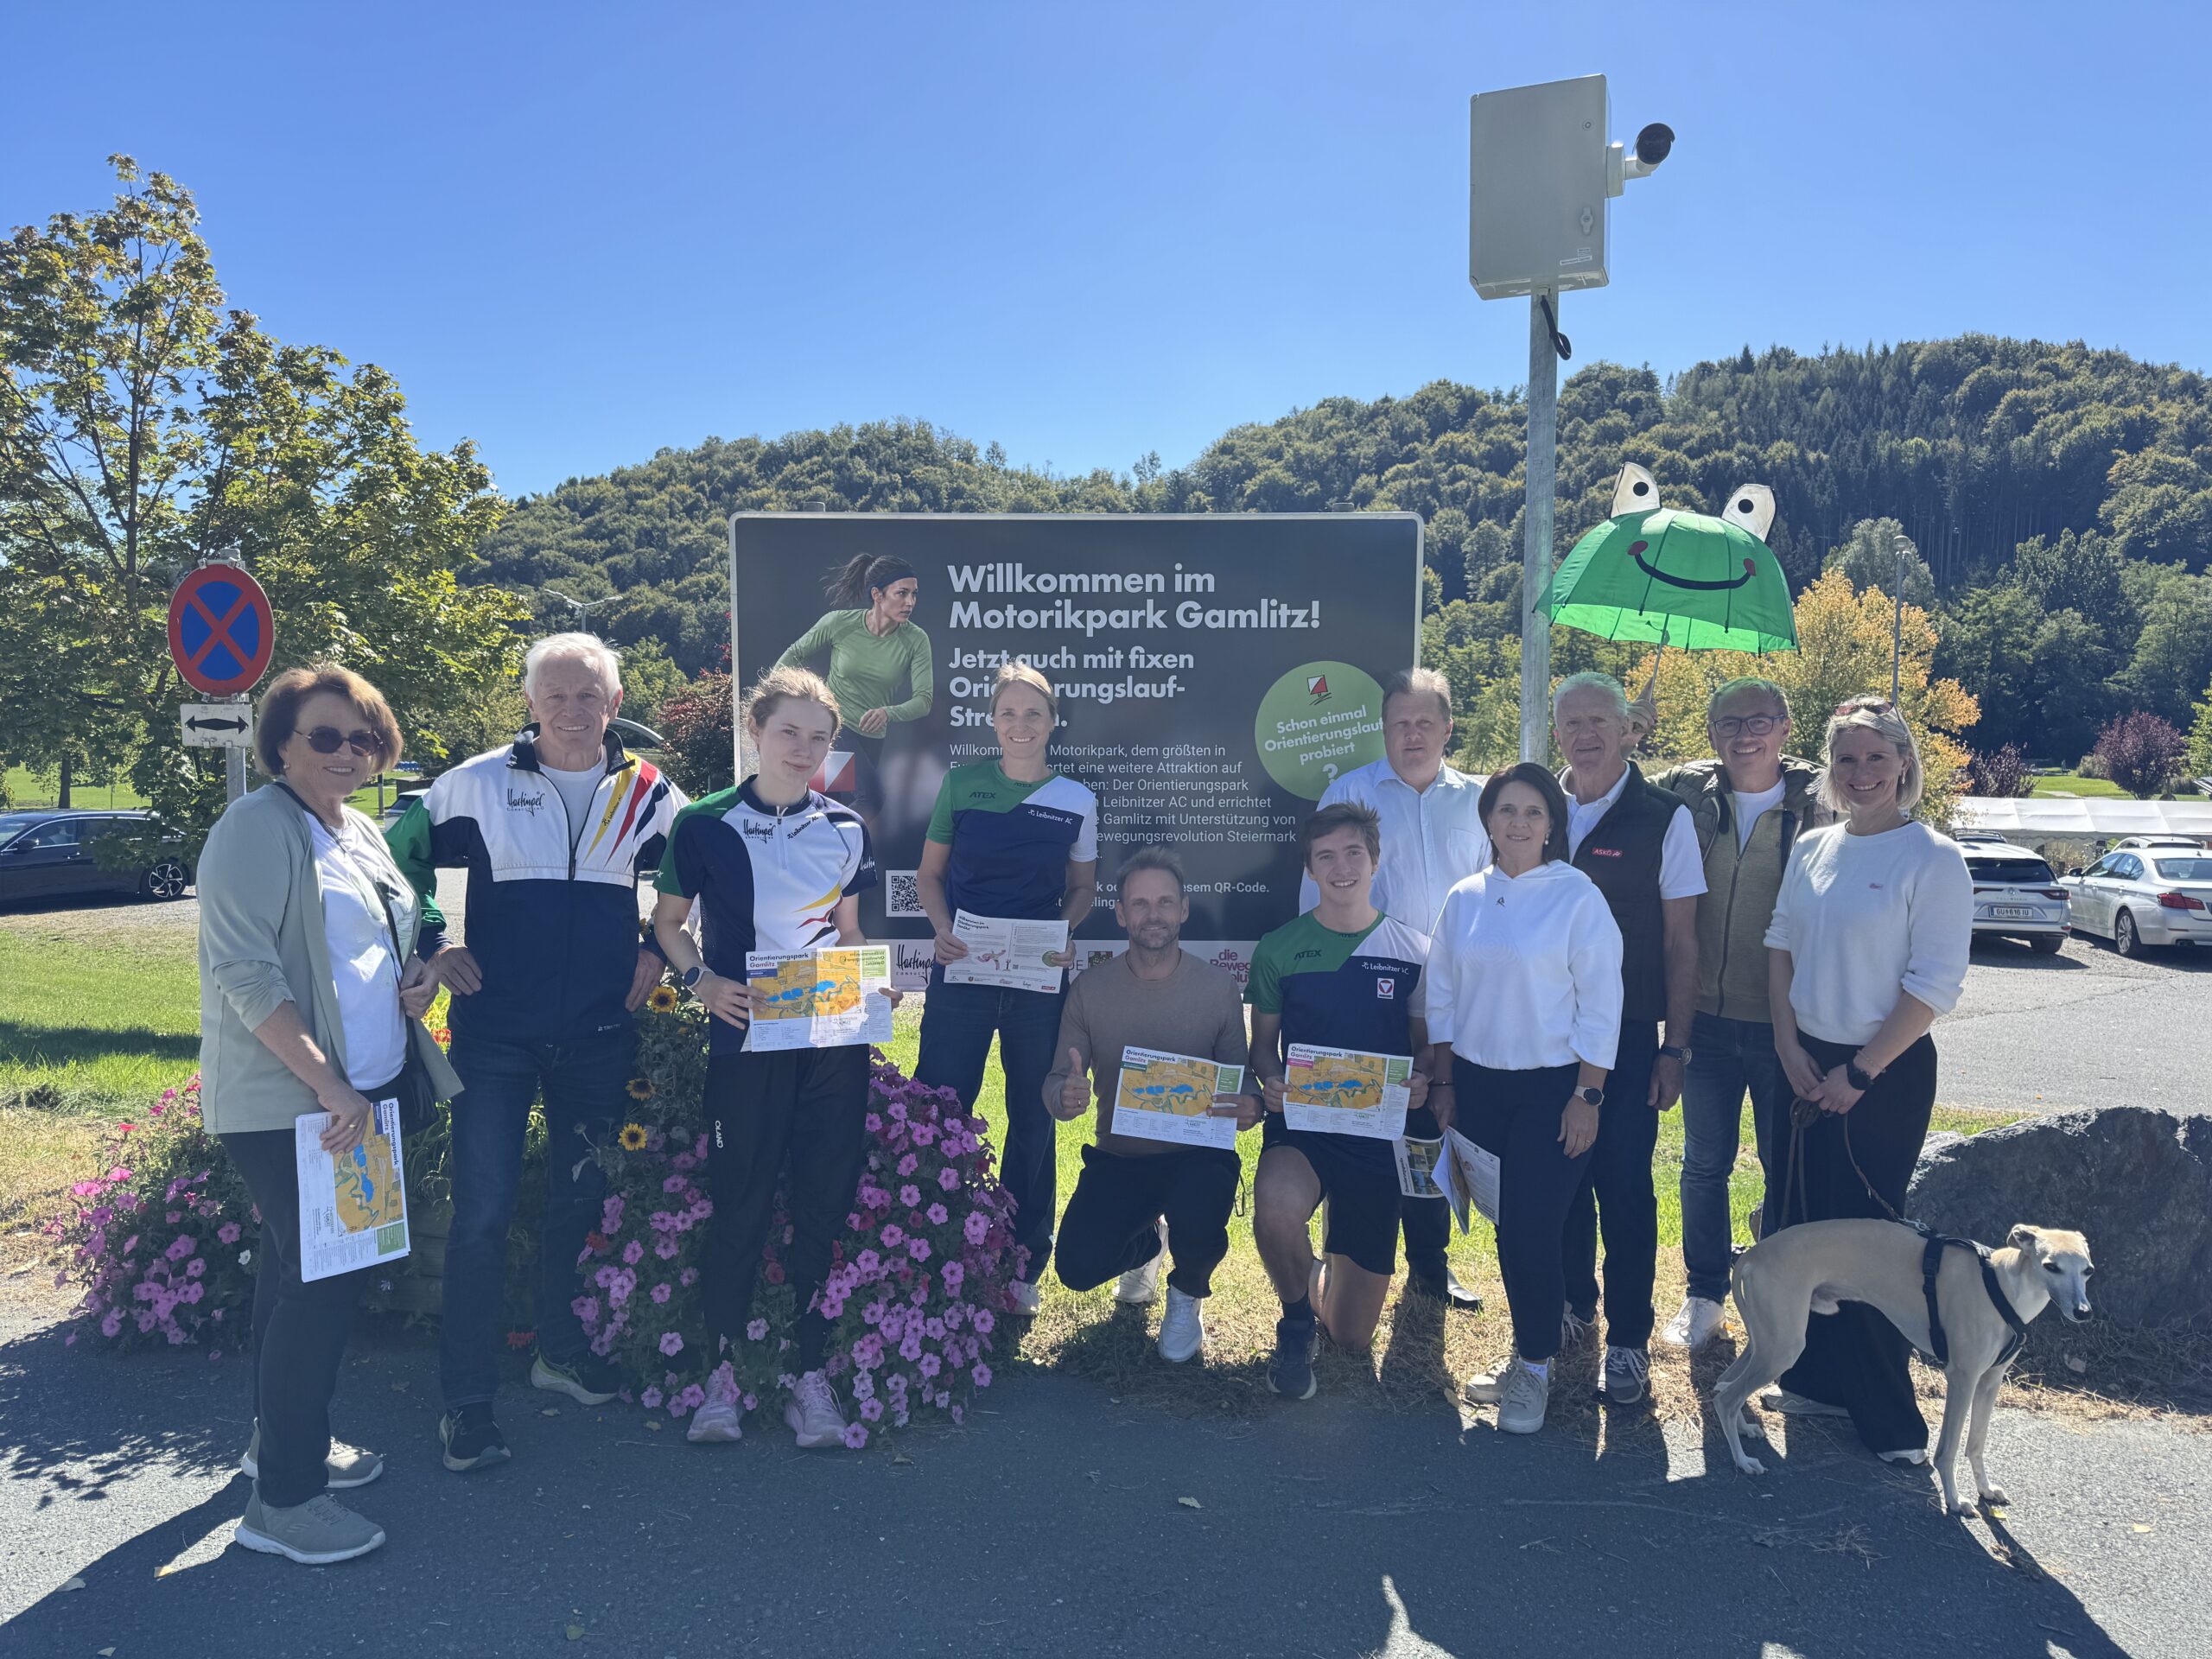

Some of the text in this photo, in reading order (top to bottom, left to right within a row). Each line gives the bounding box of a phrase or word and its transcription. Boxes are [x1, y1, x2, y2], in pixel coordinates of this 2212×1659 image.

[948, 563, 1215, 593] Willkommen im
[950, 599, 1320, 637] Motorikpark Gamlitz!
[1084, 647, 1123, 669] mit
[1129, 646, 1194, 669] fixen
[950, 675, 1185, 704] Orirungslauf-
[1277, 704, 1367, 734] Schon einmal
[1265, 717, 1384, 752] Orientierungslauf
[1050, 744, 1128, 759] Motorikpark,
[1131, 744, 1159, 756] dem
[1162, 743, 1211, 759] größten
[1215, 744, 1226, 756] in
[1300, 741, 1356, 766] probiert
[1078, 762, 1104, 773] eine
[1108, 761, 1154, 773] weitere
[1157, 761, 1218, 773] Attraktion
[1222, 760, 1243, 773] auf
[1113, 779, 1135, 791] Der
[1137, 779, 1249, 793] Orientierungspark
[1103, 796, 1166, 808] Leibnitzer
[1168, 796, 1187, 808] AC
[1191, 796, 1215, 808] und
[1217, 796, 1272, 808] errichtet
[1036, 810, 1064, 823] Leibnitzer
[1103, 812, 1152, 824] Gamlitz
[1155, 813, 1176, 824] mit
[1179, 812, 1269, 828] Unterstützung
[1273, 815, 1296, 825] von
[1096, 830, 1297, 844] ewegungsrevolution Steiermark
[1214, 881, 1269, 894] QR-Code.
[749, 952, 809, 962] Orientierungspark
[1218, 949, 1238, 961] die
[1294, 950, 1322, 960] ATEX
[1370, 963, 1401, 973] Leibnitzer
[1291, 1046, 1343, 1057] Orientierungspark
